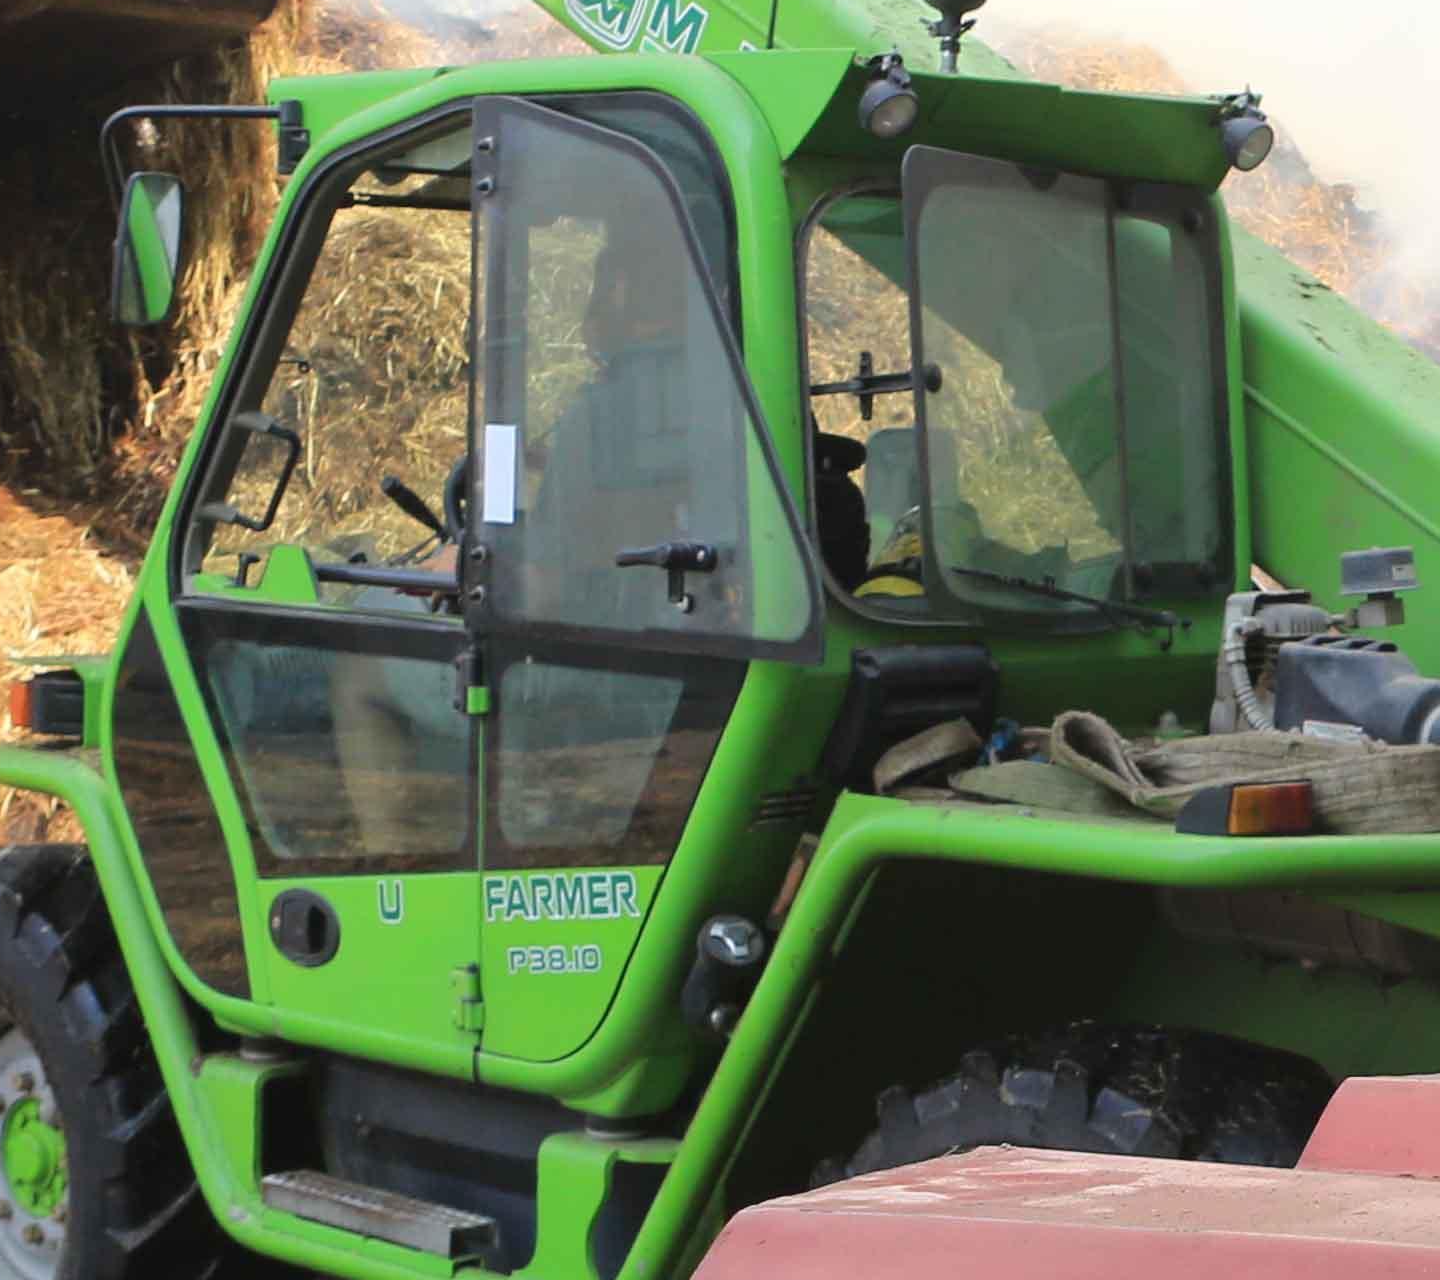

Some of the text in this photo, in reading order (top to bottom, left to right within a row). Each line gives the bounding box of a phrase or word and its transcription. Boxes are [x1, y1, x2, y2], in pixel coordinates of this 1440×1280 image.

[378, 873, 640, 923] U FARMER
[509, 946, 600, 972] P38.10
